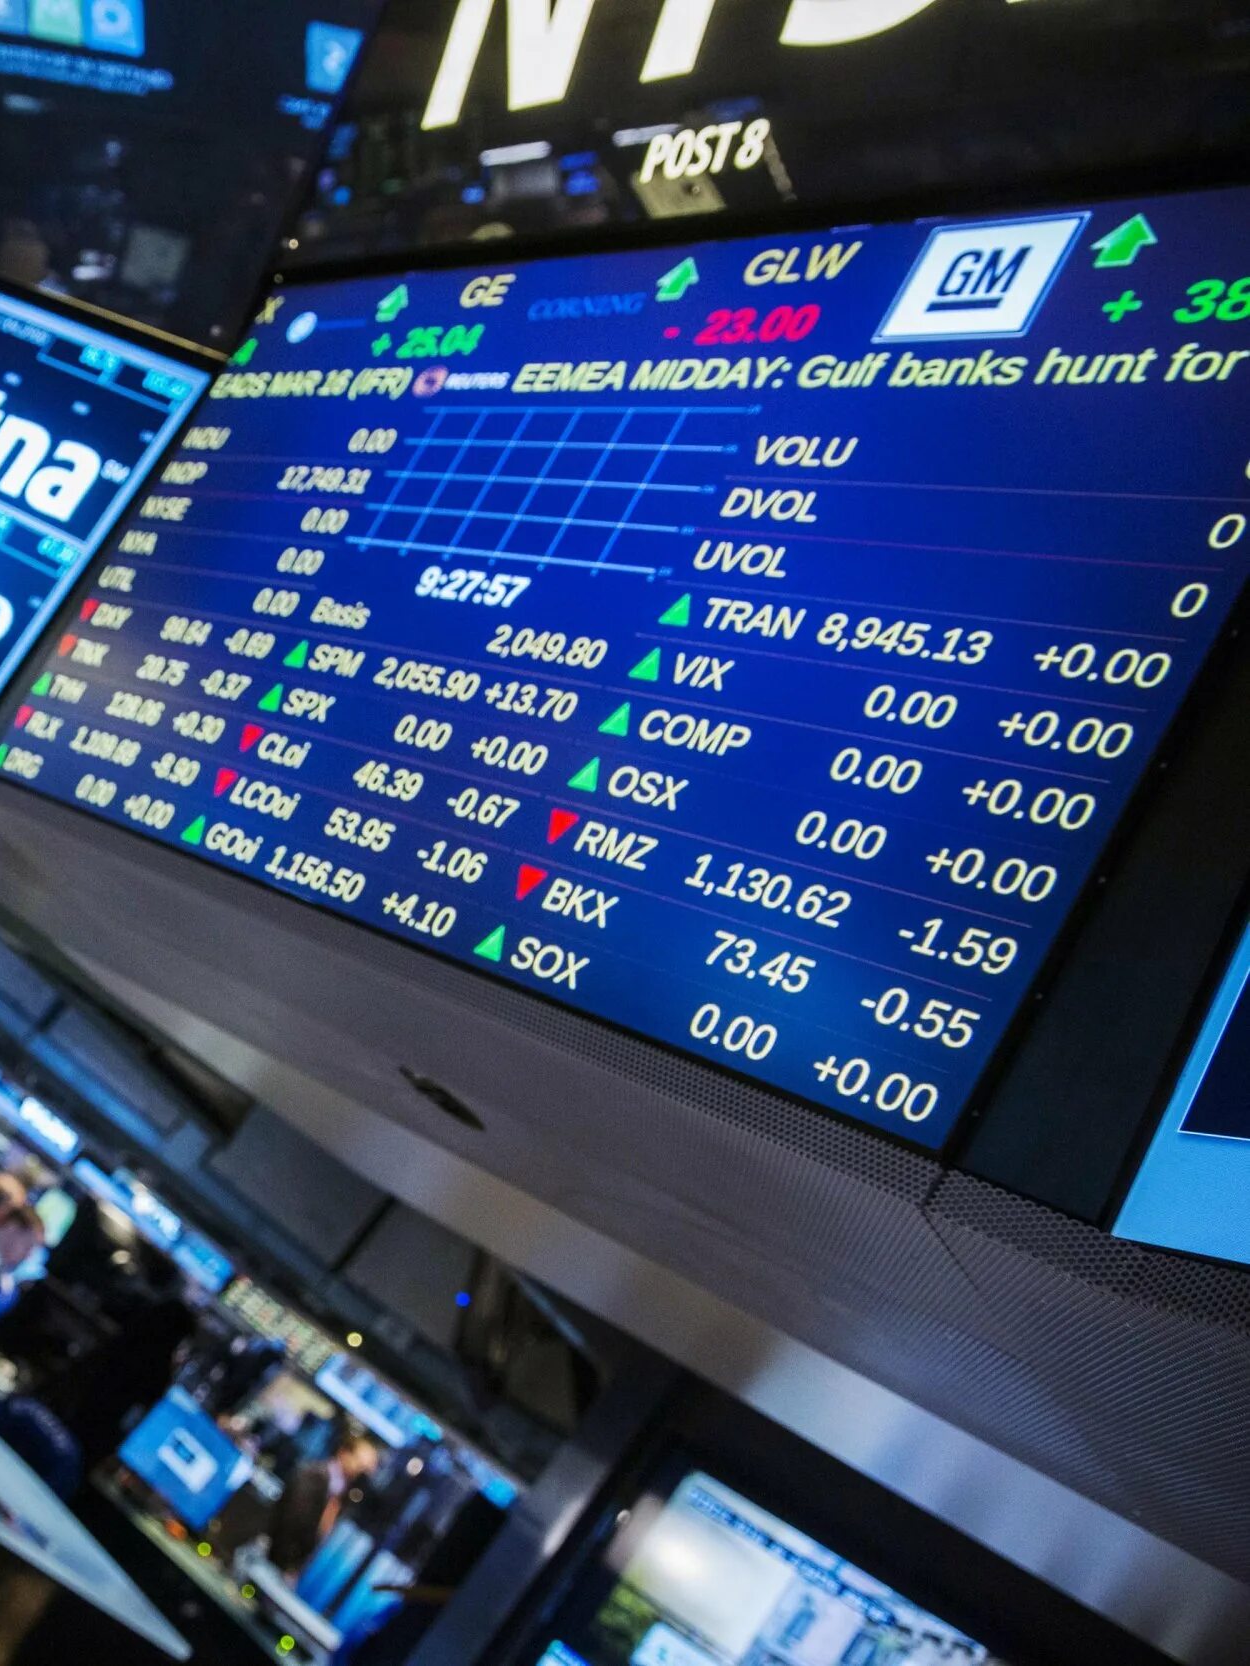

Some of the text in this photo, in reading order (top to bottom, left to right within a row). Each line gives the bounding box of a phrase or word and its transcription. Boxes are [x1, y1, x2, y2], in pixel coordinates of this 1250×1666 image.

[639, 119, 770, 183] POST 8
[744, 242, 863, 287] GLW
[936, 245, 1033, 298] GM
[459, 274, 516, 308] GE
[694, 304, 821, 345] 23.00
[511, 342, 1250, 393] EEMEA MIDDAY: Gulf banks hunt for
[752, 436, 858, 467] VOLU
[720, 489, 818, 523] DVOL
[692, 540, 788, 579] UVOL
[415, 565, 531, 607] 9:27:57
[372, 656, 481, 702] 2,055.90
[484, 682, 579, 722] +13.70
[703, 597, 807, 640] TRAN
[816, 612, 993, 665] 8,945.13
[1034, 642, 1172, 688] +0.00
[486, 624, 608, 669] 2,049.80
[282, 687, 336, 723] SPX
[393, 714, 453, 751] 0.00
[470, 736, 549, 776] +0.00
[672, 652, 735, 692] VIX
[862, 684, 958, 729] 0.00
[998, 711, 1134, 759] +0.00
[353, 760, 424, 802] 46.39
[447, 787, 520, 828] -0.67
[638, 709, 752, 756] COMP
[829, 747, 923, 795] 0.00
[961, 779, 1097, 830] +0.00
[324, 807, 397, 852] 53.95
[417, 841, 489, 884] -1.06
[607, 765, 689, 811] OSX
[794, 810, 888, 860] 0.00
[925, 847, 1058, 902] +0.00
[264, 845, 366, 903] 1,156.50
[382, 891, 457, 937] +4.10
[573, 820, 659, 871] RMZ
[684, 853, 852, 928] 1,130.62
[898, 918, 1019, 975] -1.59
[541, 878, 981, 1049] BKX 73.45 -0.55
[510, 937, 940, 1123] SOX 0.00 +0.00
